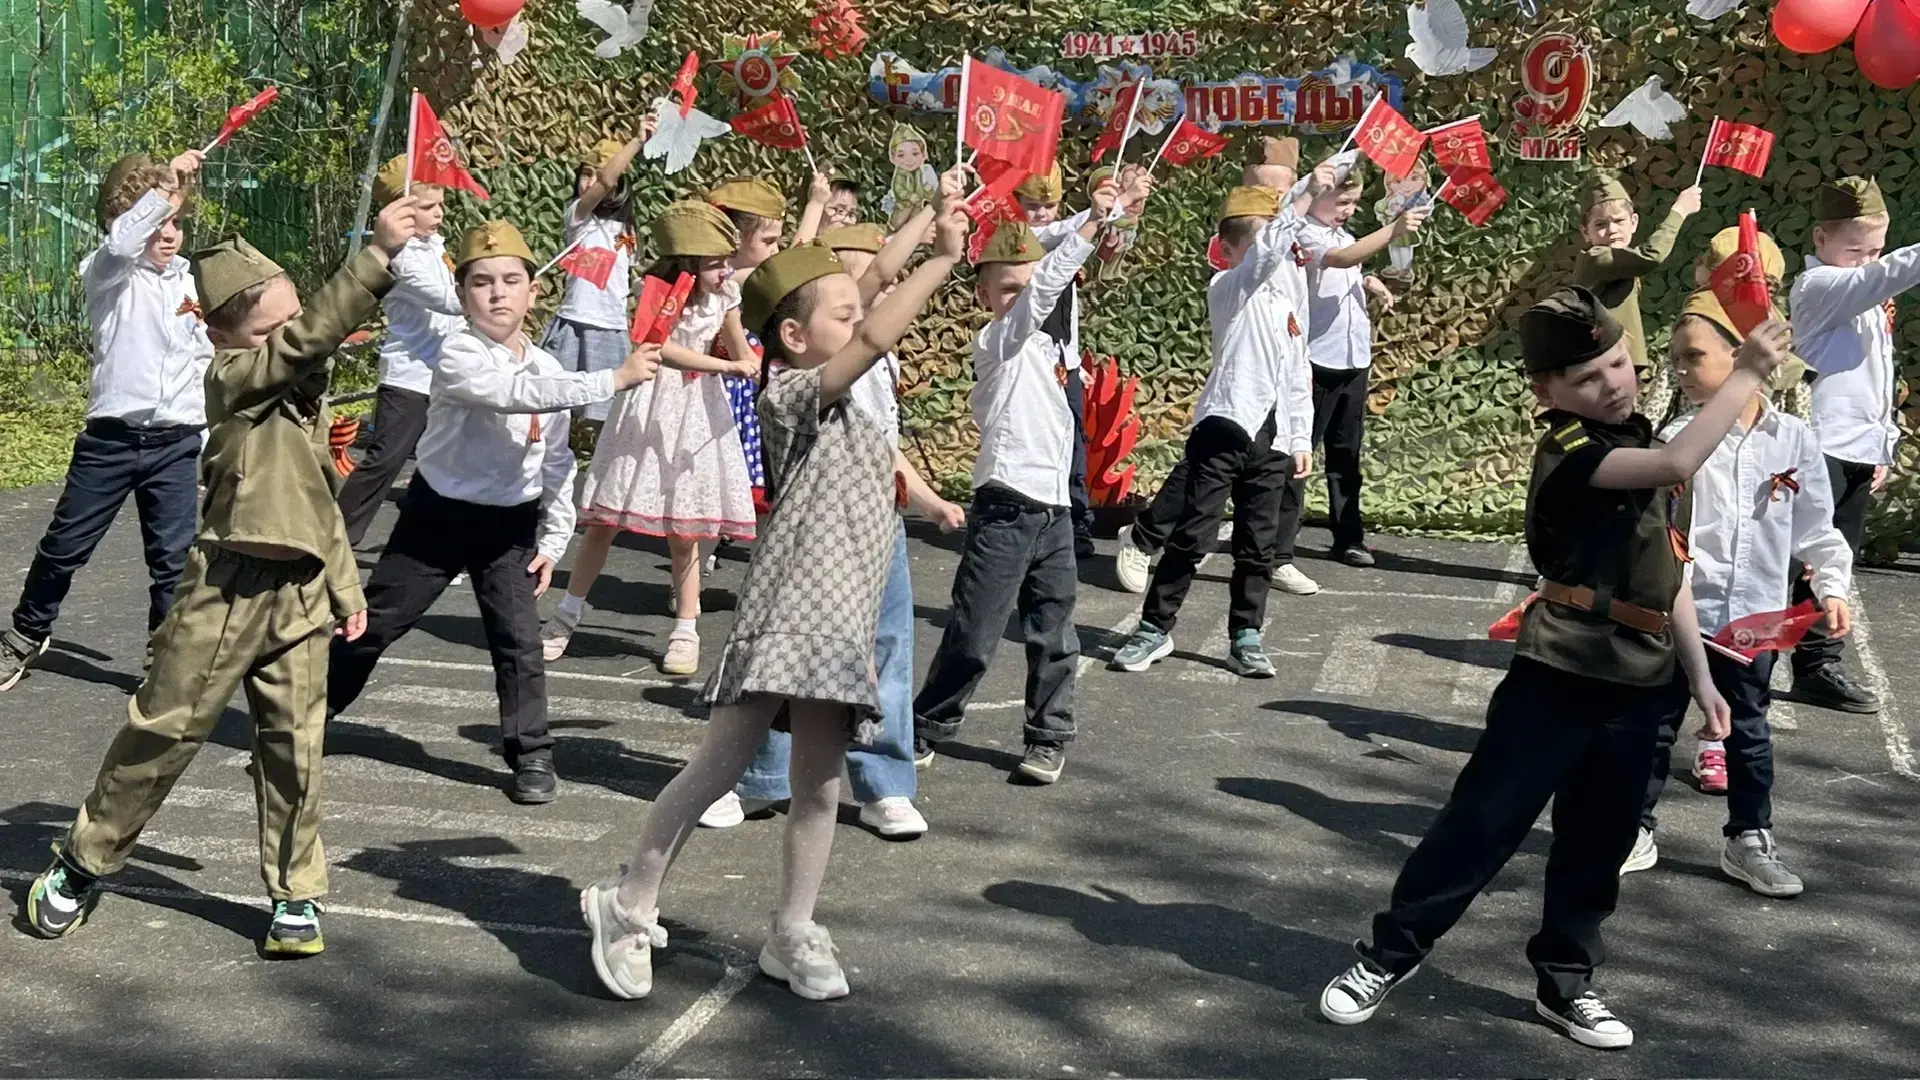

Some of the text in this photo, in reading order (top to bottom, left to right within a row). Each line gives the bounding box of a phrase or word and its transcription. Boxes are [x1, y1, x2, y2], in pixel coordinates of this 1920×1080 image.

[1062, 32, 1197, 57] 1941 1945
[1522, 32, 1592, 128] 9
[1521, 138, 1580, 159] МАЯ
